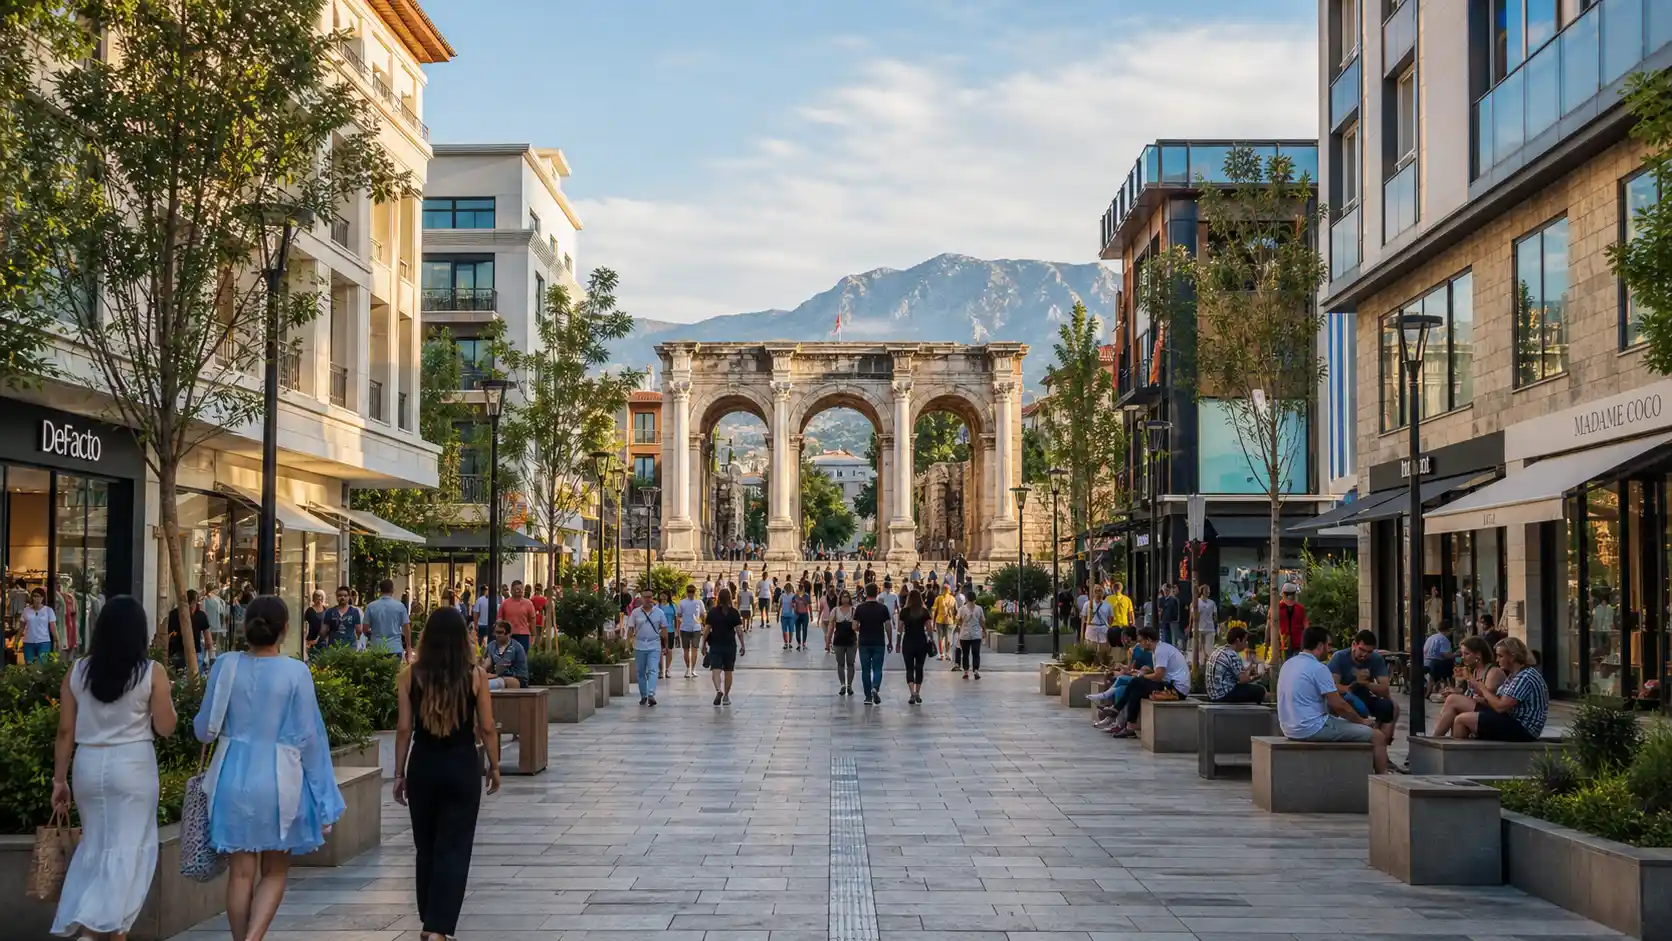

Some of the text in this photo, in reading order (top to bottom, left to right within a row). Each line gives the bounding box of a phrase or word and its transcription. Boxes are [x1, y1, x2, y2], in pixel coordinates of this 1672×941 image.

[1574, 393, 1661, 437] MADAME COCO
[43, 419, 101, 461] DeFacto
